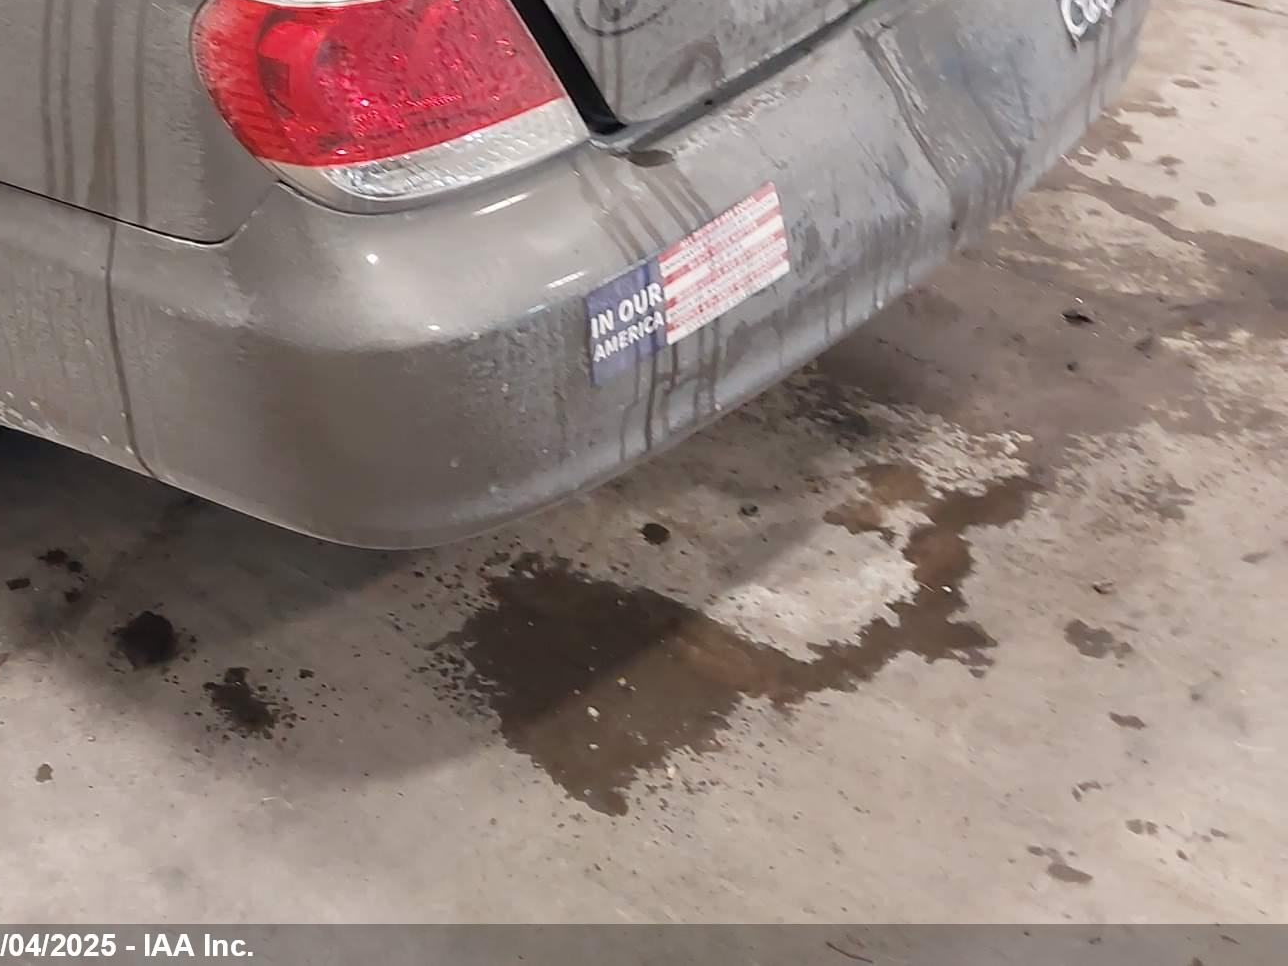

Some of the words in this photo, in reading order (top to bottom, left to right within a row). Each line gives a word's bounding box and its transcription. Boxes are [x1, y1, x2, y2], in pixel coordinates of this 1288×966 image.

[590, 308, 615, 339] IN
[618, 282, 663, 323] OUR
[593, 310, 665, 363] AMERICA
